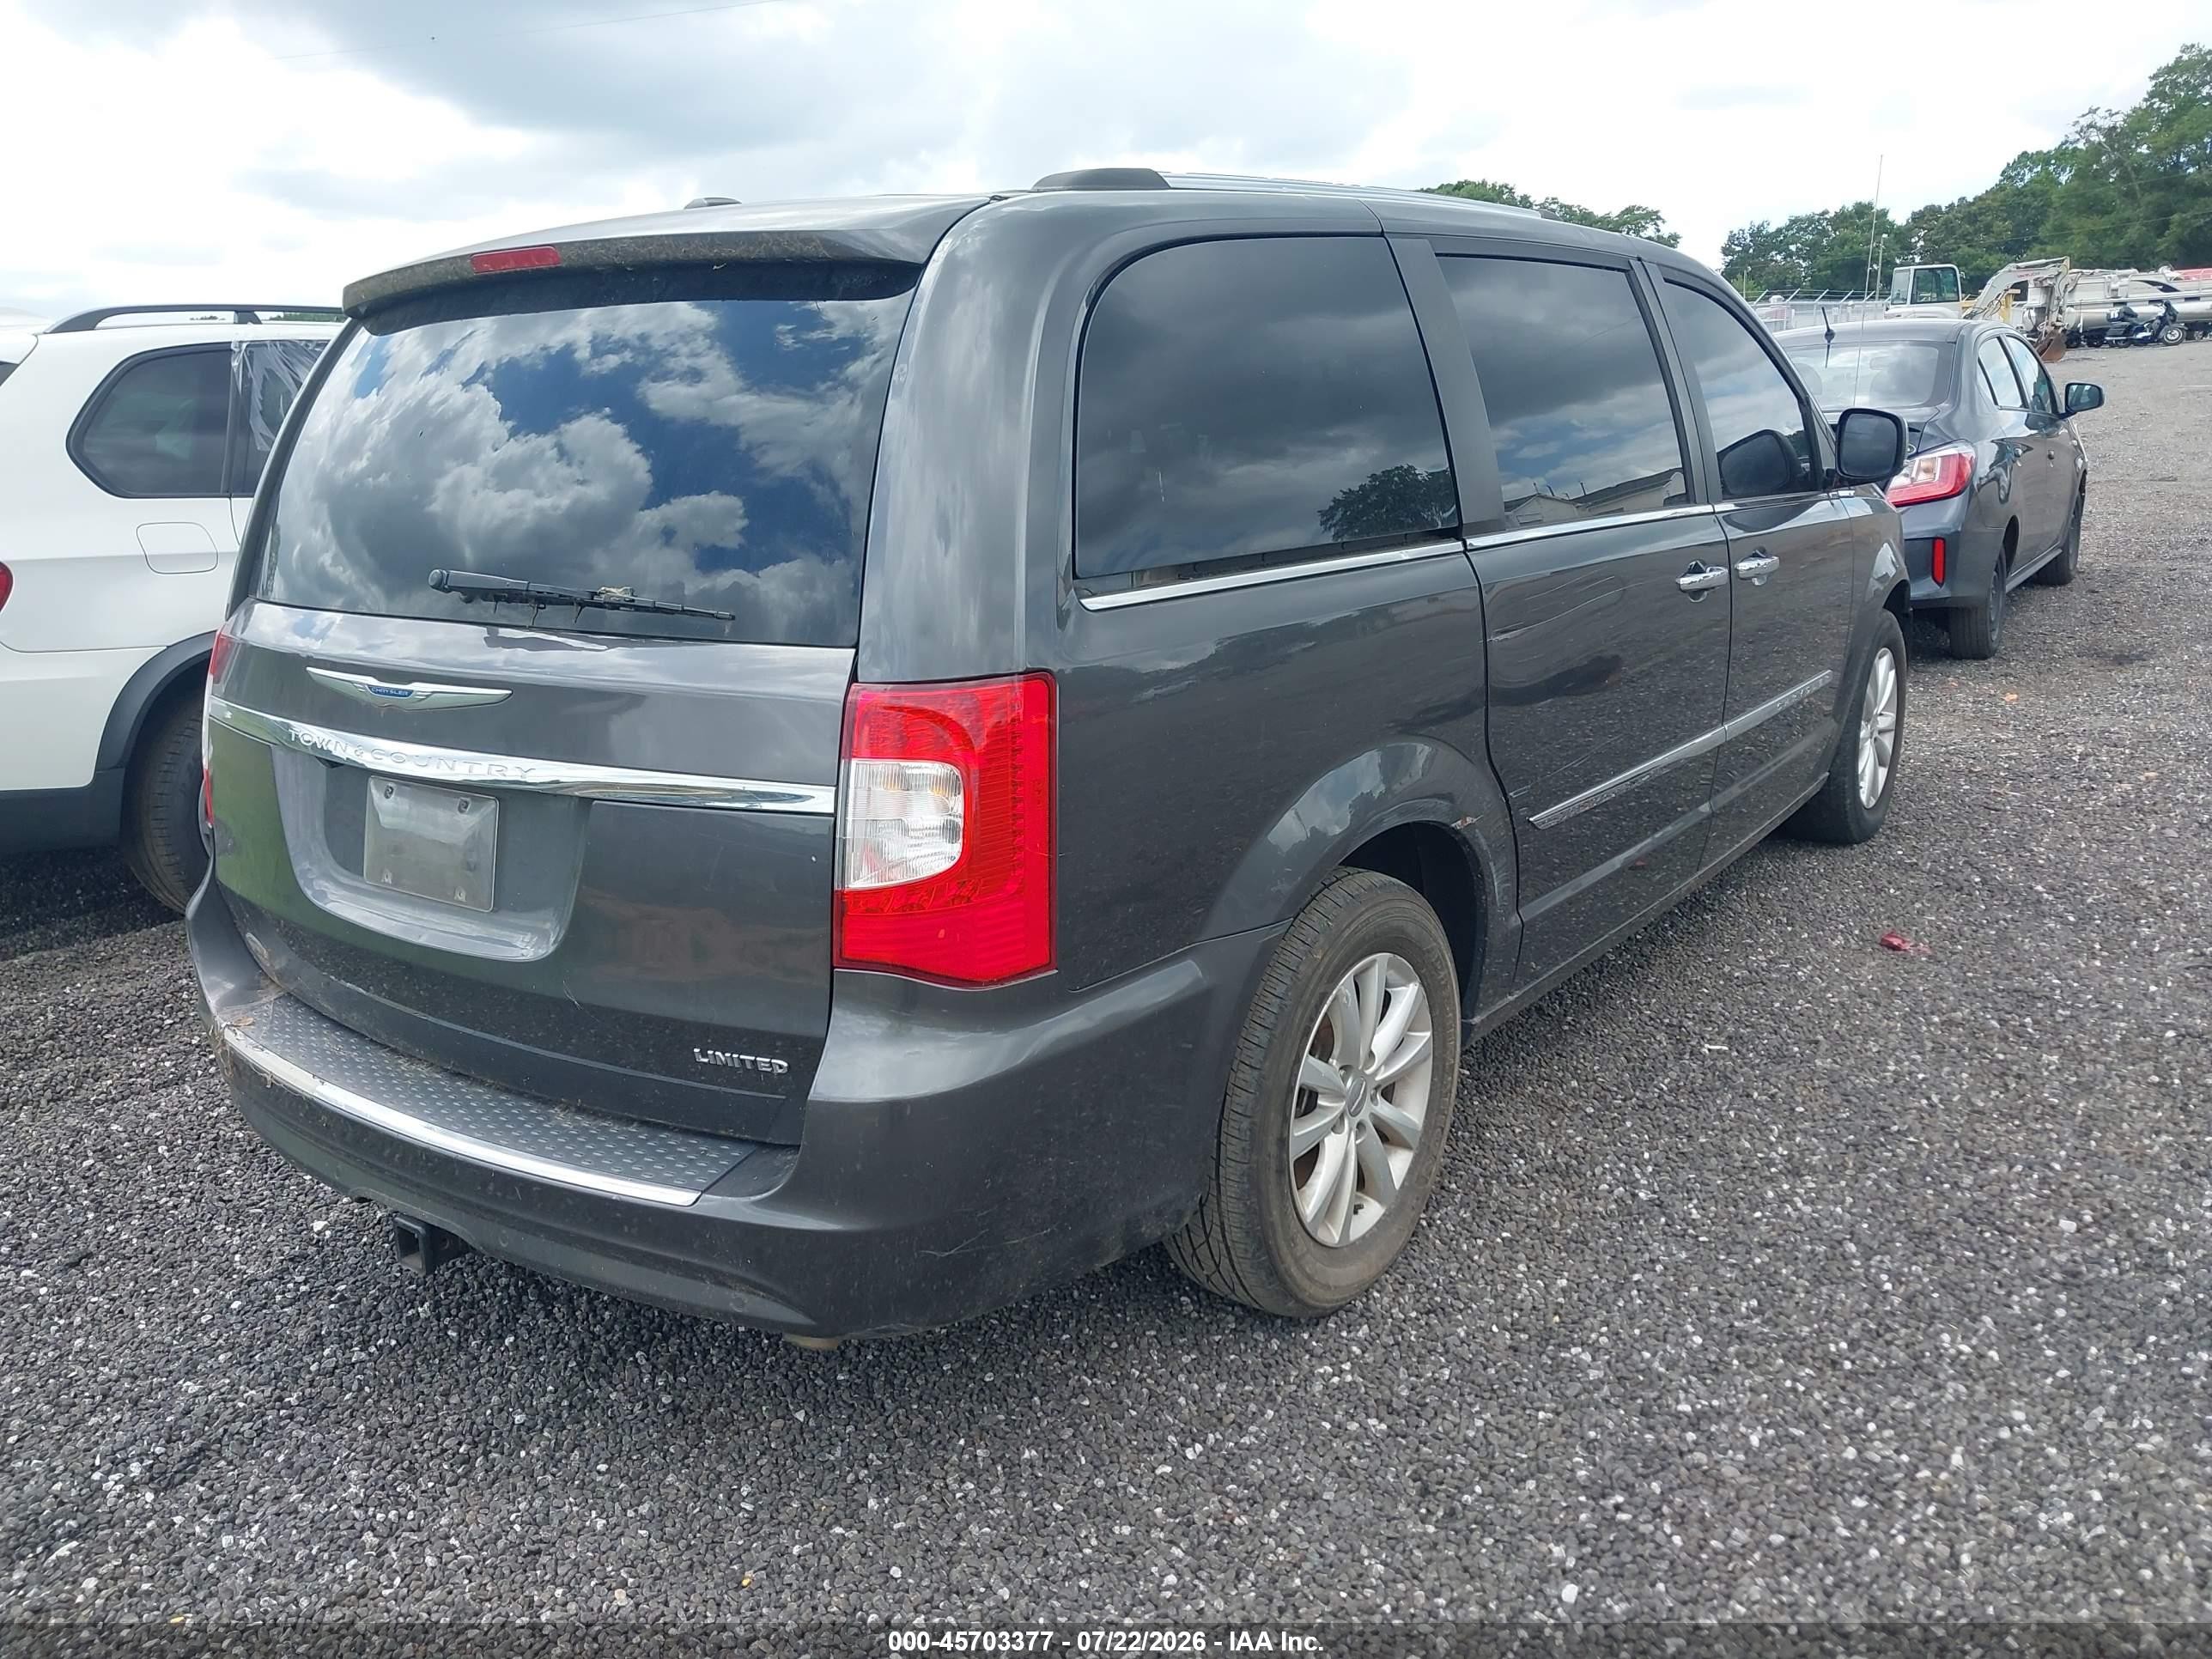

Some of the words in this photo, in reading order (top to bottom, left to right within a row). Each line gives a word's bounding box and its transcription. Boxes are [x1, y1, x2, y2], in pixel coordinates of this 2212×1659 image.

[371, 687, 410, 696] CHRYSLER
[289, 727, 348, 756] TOWN
[370, 748, 537, 779] COUNTRY
[693, 1048, 788, 1074] LIMITED
